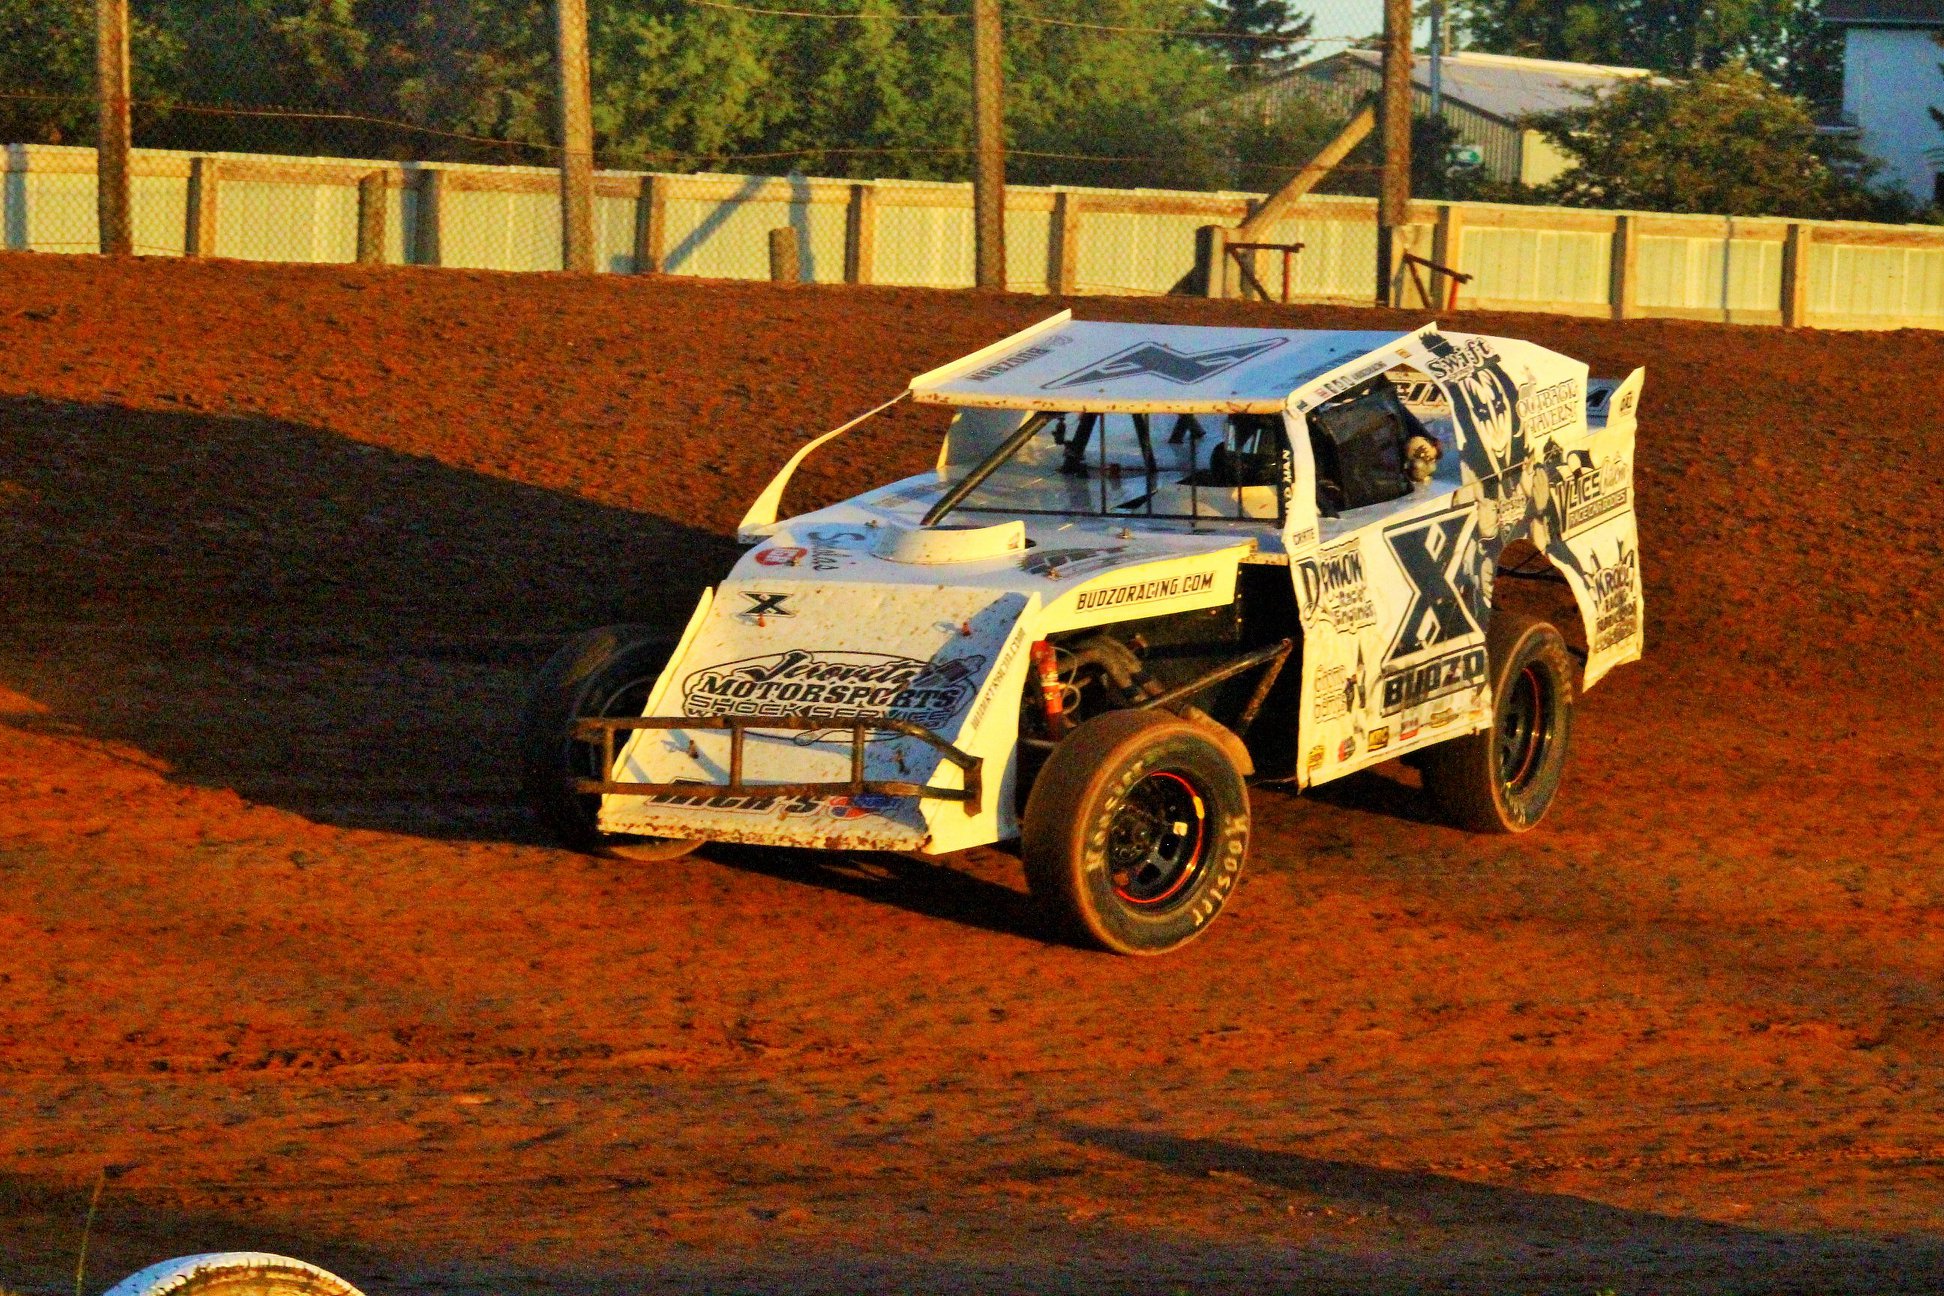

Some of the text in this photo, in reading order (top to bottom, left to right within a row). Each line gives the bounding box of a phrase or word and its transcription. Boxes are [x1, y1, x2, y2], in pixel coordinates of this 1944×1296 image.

[1427, 337, 1493, 378] Swift
[1077, 573, 1214, 611] BUDZORACING.COM
[701, 675, 958, 708] MOTORSPORTS
[1384, 649, 1484, 710] BUDZO
[688, 694, 804, 717] SHOCK
